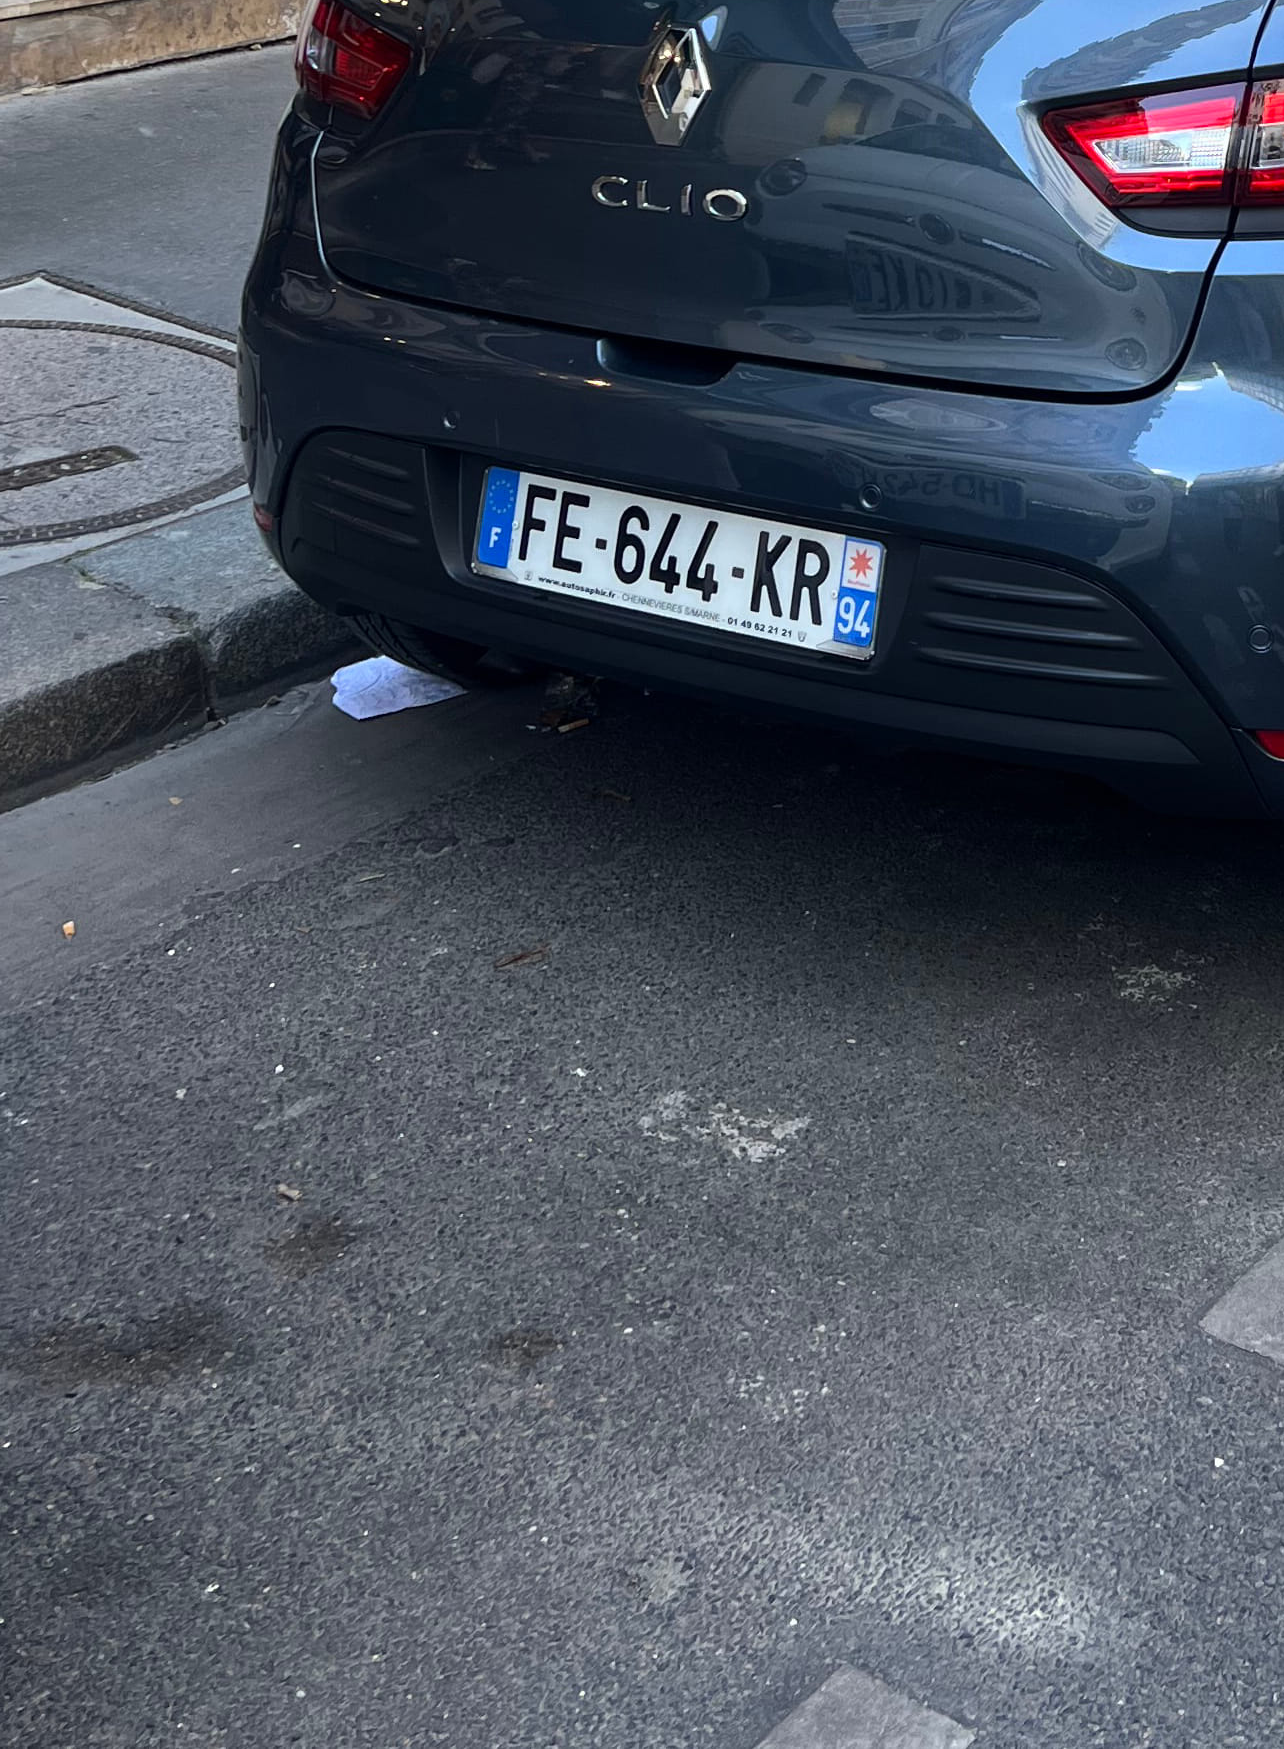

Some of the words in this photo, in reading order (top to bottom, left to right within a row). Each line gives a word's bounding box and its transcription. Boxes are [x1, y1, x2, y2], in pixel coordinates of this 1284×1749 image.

[591, 175, 747, 221] CLIO
[489, 526, 502, 548] F
[518, 483, 830, 626] FE-644-KR
[621, 592, 682, 614] CHENNEVIERES
[727, 617, 738, 626] 01
[767, 625, 778, 635] 21
[781, 629, 792, 638] 21
[837, 596, 870, 638] 94
